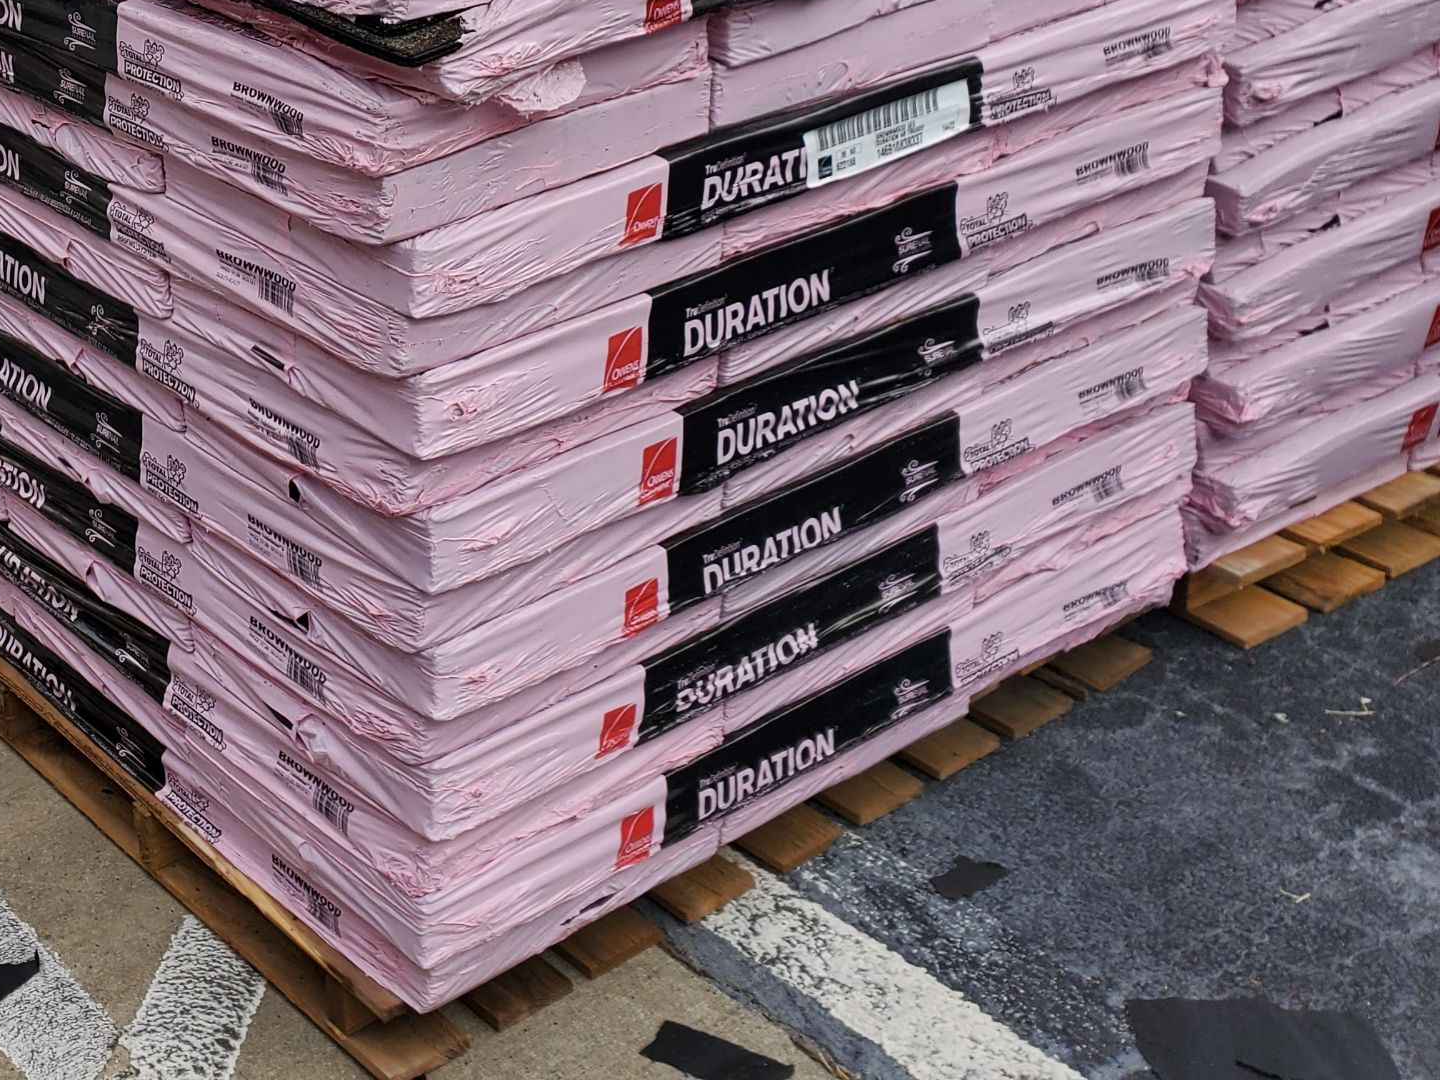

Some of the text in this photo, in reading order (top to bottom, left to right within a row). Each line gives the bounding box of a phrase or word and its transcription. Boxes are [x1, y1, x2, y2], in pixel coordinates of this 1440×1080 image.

[124, 46, 144, 62] TOTAL
[1103, 26, 1172, 56] BROWNWOOD
[124, 61, 182, 93] PROTECTION
[112, 99, 133, 116] TOTAL
[233, 81, 305, 121] BROWNWOOD
[110, 116, 165, 146] PROTECTION
[211, 136, 287, 174] BROWNWOOD
[1075, 141, 1150, 177] BROWNWOOD
[701, 146, 807, 211] DURATI
[114, 207, 132, 224] TOTAL
[967, 212, 1027, 248] PROTECTION
[216, 248, 297, 293] BROWNWOOD
[1096, 257, 1170, 286] BROWNWOOD
[683, 268, 832, 357] DURATION
[144, 347, 163, 364] TOTAL
[142, 361, 197, 403] PROTECTION
[716, 380, 860, 466] DURATION
[146, 460, 168, 478] TOTAL
[970, 445, 991, 458] TOTAL
[972, 438, 1030, 472] PROTECTION
[146, 471, 199, 513] PROTECTION
[1052, 465, 1123, 507] BROWNWOOD
[247, 513, 323, 568] BROWNWOOD
[702, 506, 843, 595] DURATION
[143, 554, 161, 571] TOTAL
[140, 567, 194, 608] PROTECTION
[249, 615, 328, 686] BROWNWOOD
[674, 622, 820, 712] DURATION
[176, 684, 195, 702] TOTAL
[171, 696, 224, 741] PROTECTION
[278, 749, 355, 813] BROWNWOOD
[698, 728, 836, 821] DURATION
[168, 791, 222, 838] PROTECTION
[271, 853, 342, 918] BROWNWOOD
